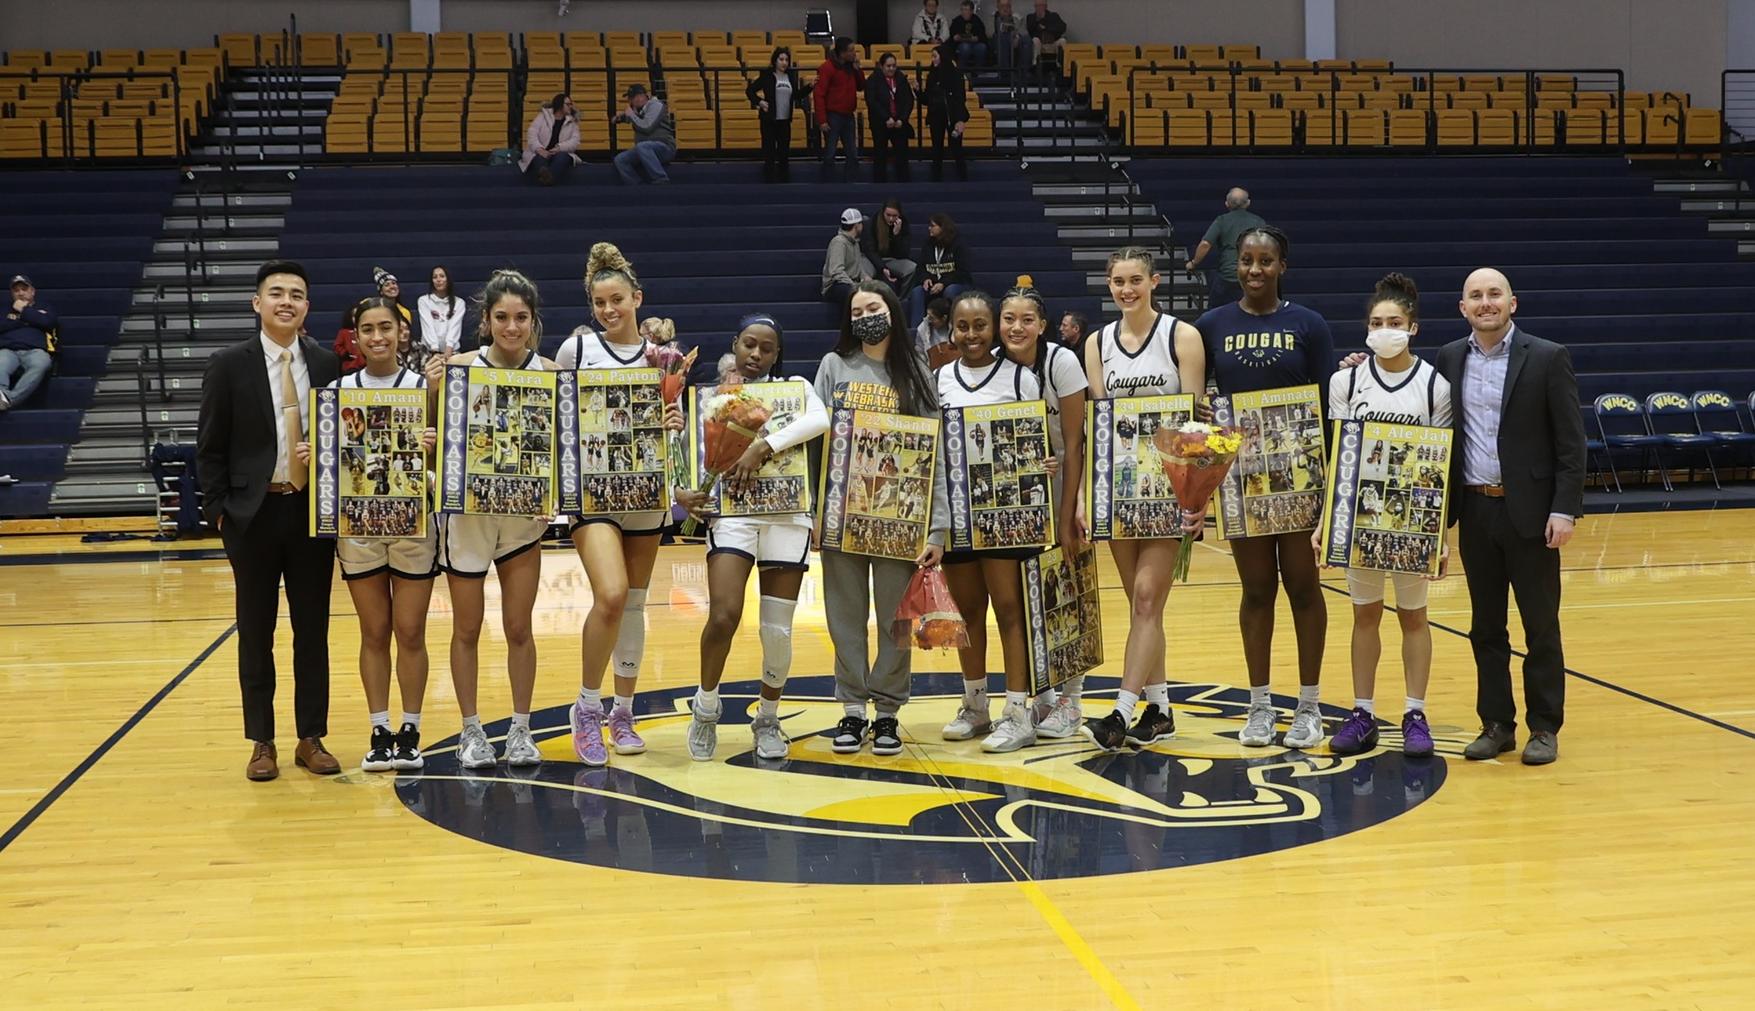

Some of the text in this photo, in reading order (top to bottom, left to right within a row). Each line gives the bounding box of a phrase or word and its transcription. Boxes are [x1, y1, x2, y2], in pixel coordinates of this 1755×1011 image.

[1224, 332, 1295, 353] COUGAR
[504, 370, 543, 385] Yara
[609, 370, 658, 384] Payton
[1106, 370, 1167, 396] Cougars
[372, 391, 422, 403] Amani
[844, 391, 899, 409] NEBRASK
[1262, 390, 1316, 403] Aminata
[1602, 396, 1636, 411] WNCC
[1653, 395, 1688, 409] WNCC
[1697, 393, 1730, 408] WNCC
[997, 404, 1037, 417] Genet
[447, 380, 464, 491] COUGARS
[559, 383, 577, 493] COUGARS
[319, 402, 335, 515] COUGARS
[1096, 413, 1109, 519] COUGARS
[1215, 409, 1239, 517] CARS
[827, 422, 848, 529] COUGARS
[947, 421, 966, 529] COUGARS
[1334, 435, 1357, 544] COUGARS
[1028, 570, 1046, 671] COUGARS
